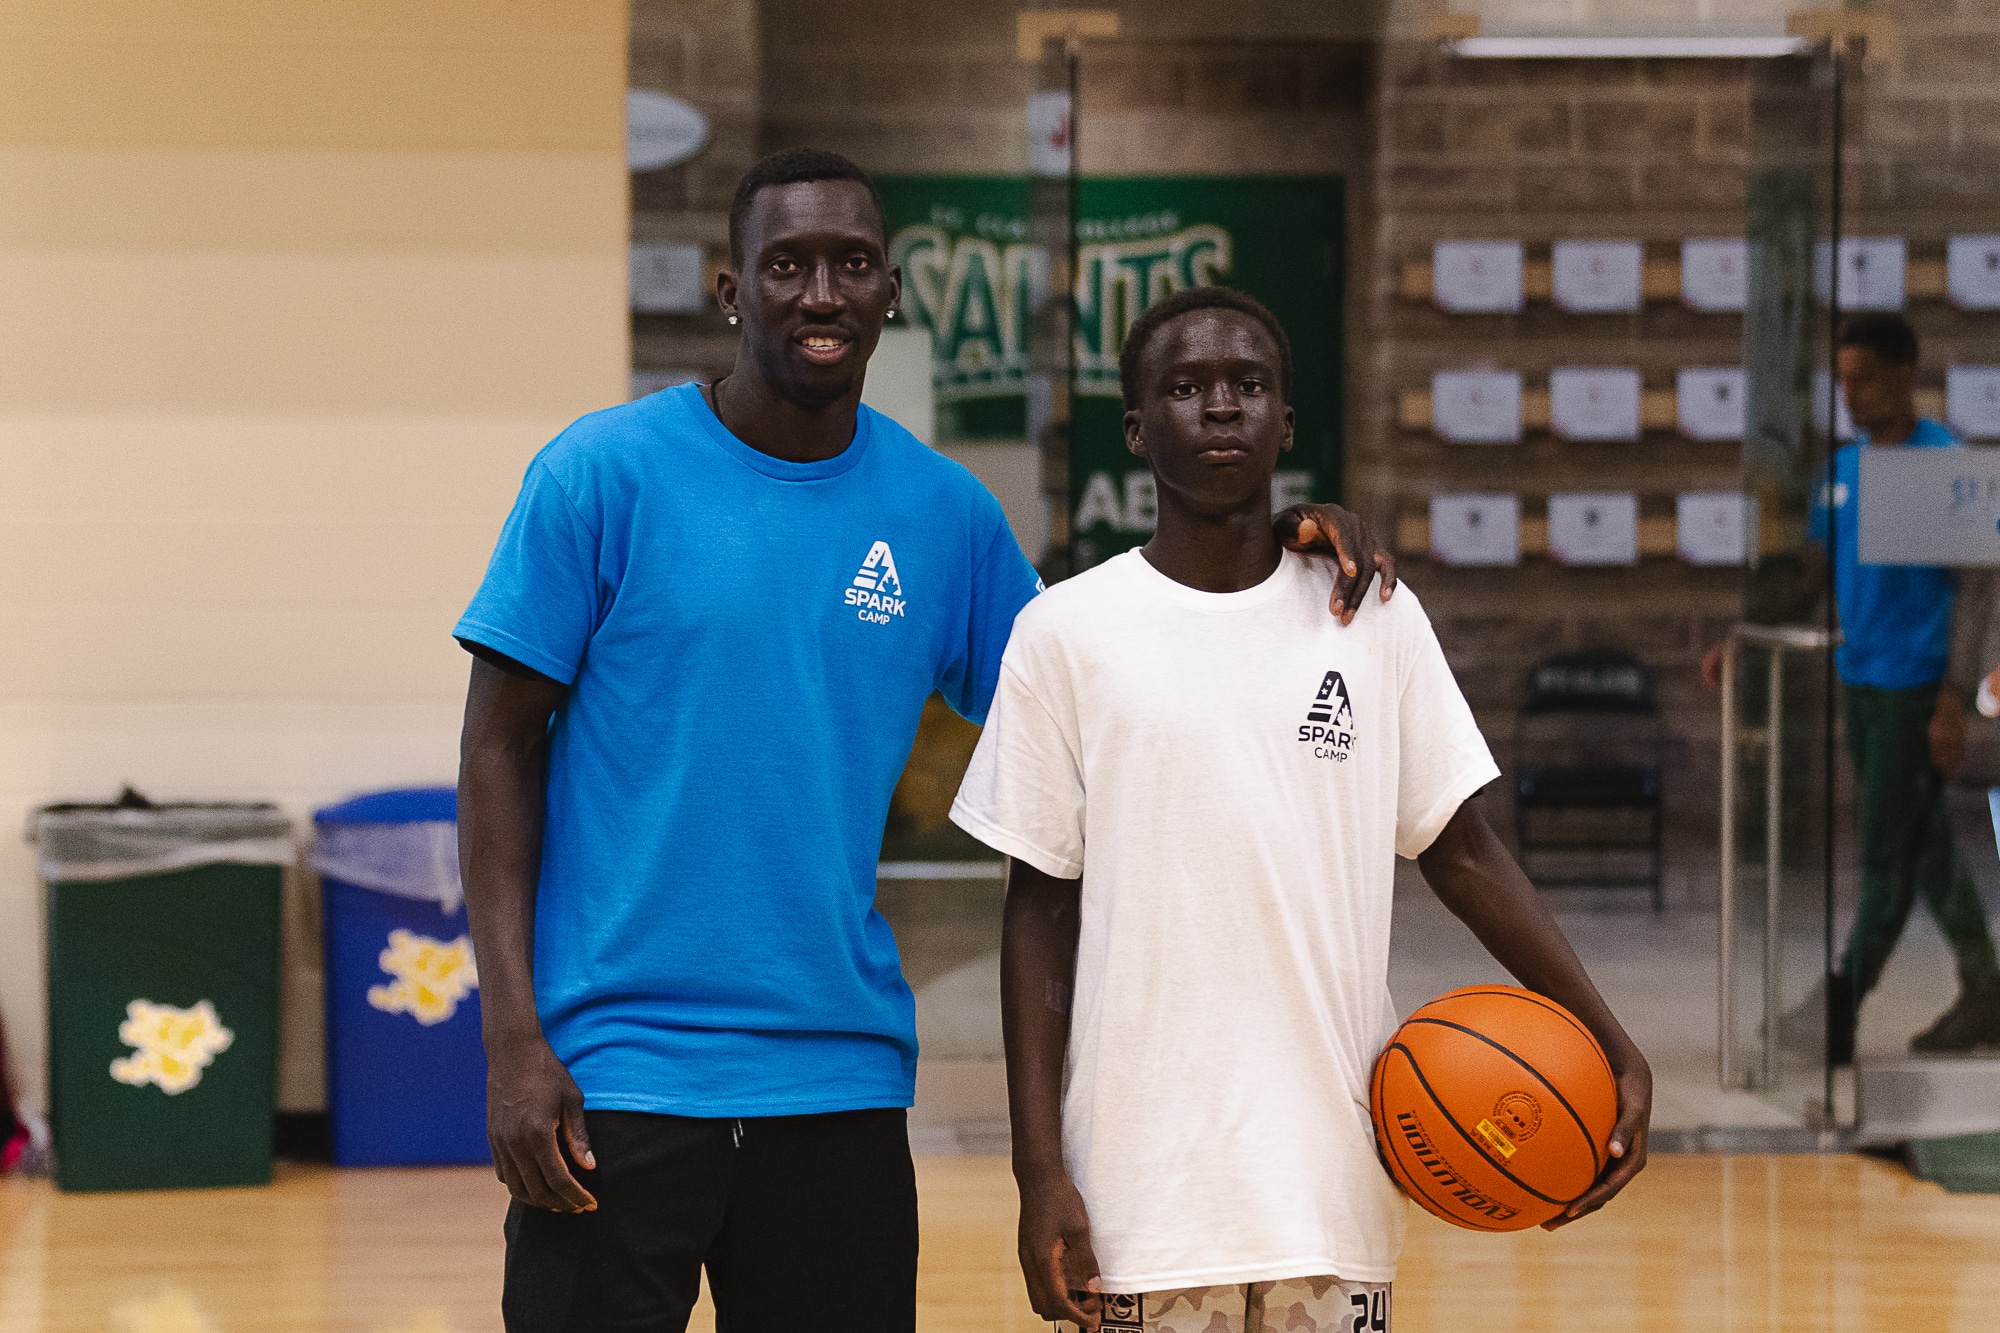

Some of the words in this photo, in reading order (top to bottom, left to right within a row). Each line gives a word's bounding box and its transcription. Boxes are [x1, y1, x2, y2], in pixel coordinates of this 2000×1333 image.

[844, 588, 907, 617] SPARK
[857, 609, 891, 625] CAMP
[1314, 747, 1348, 762] CAMP
[1396, 1112, 1518, 1221] EVOLUTION
[1350, 1290, 1387, 1333] 24
